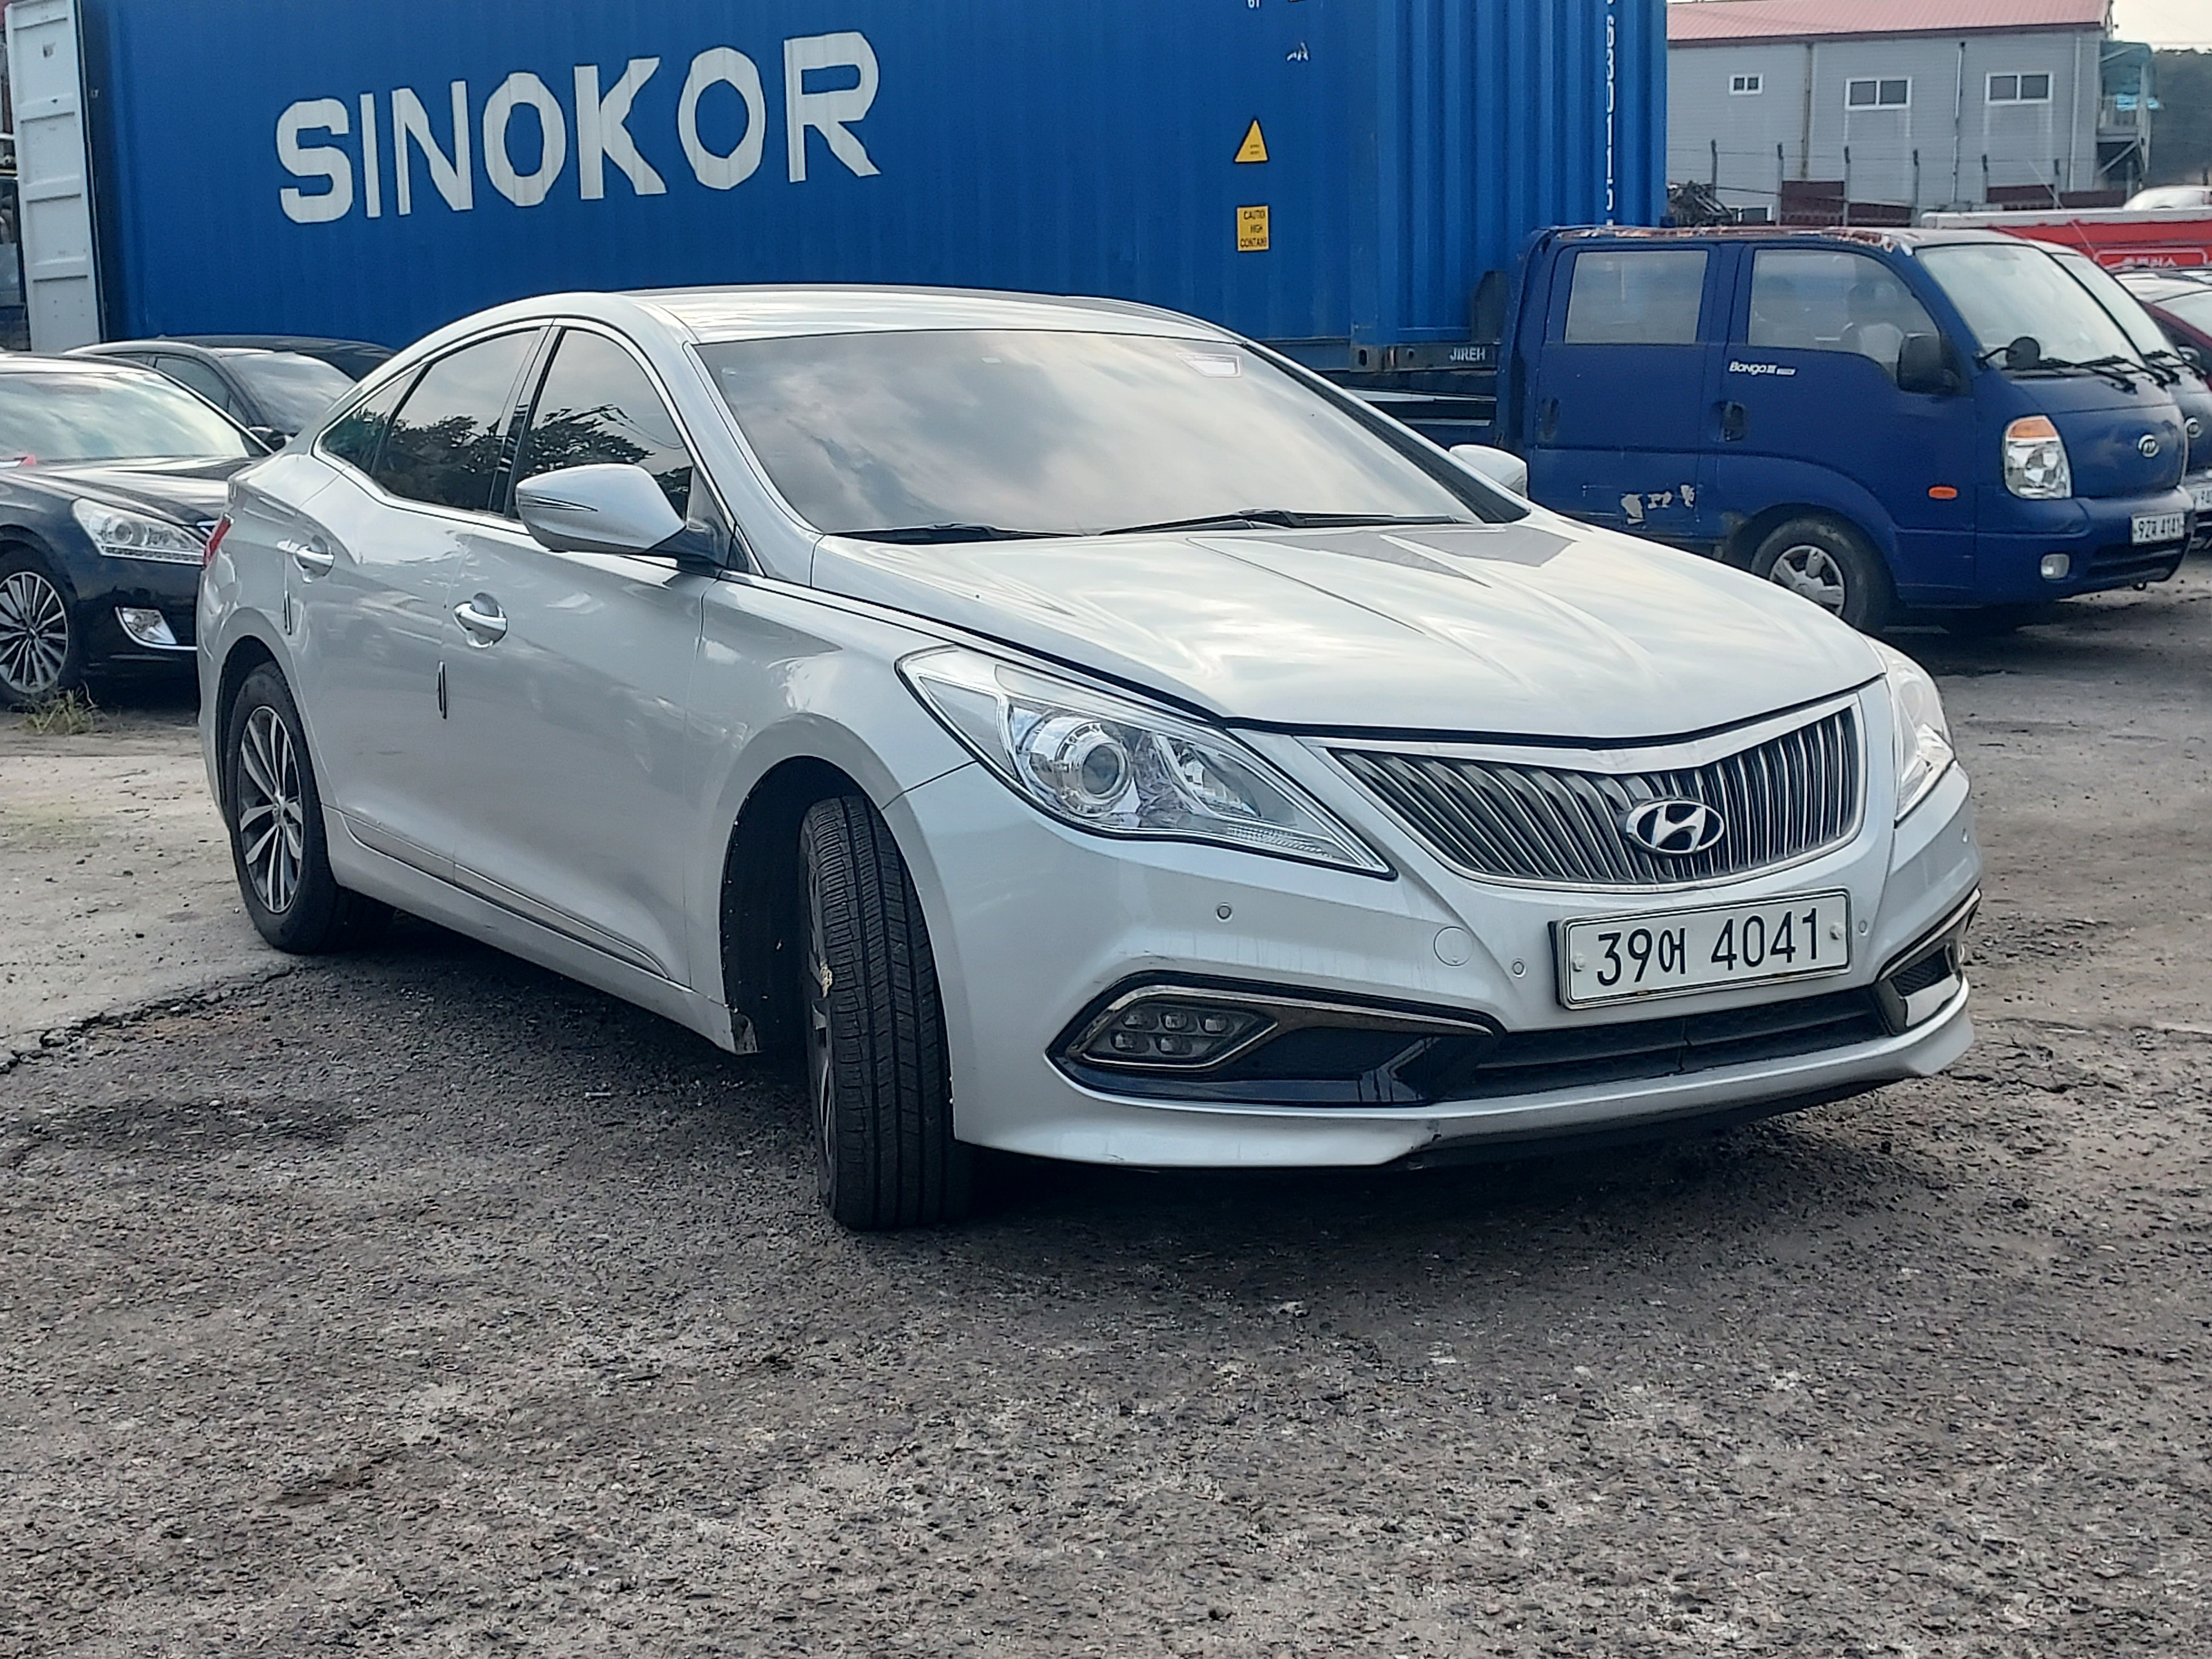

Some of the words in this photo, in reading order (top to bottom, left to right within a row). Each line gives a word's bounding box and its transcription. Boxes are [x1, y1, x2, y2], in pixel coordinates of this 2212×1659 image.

[276, 32, 881, 223] SINOKOR
[1449, 347, 1486, 361] JIREH
[1597, 927, 1686, 986] 39어
[1710, 907, 1817, 971] 4041
